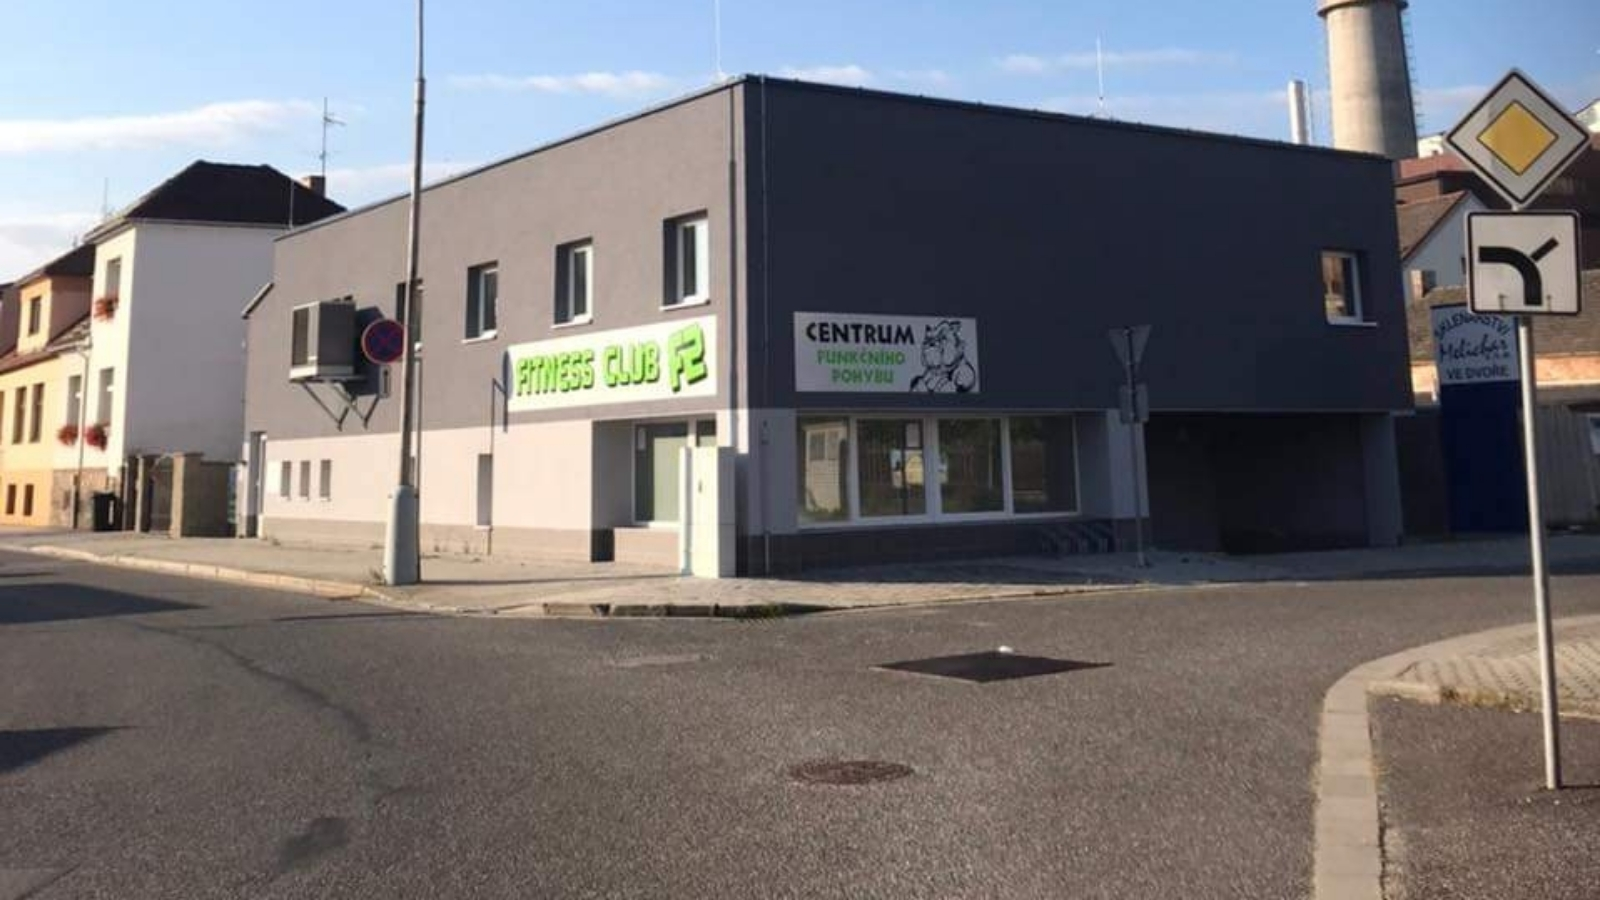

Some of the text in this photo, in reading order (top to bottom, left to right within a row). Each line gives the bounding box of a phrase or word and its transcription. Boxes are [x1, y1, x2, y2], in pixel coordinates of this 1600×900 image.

[805, 322, 915, 345] CENTRUM
[516, 349, 595, 396] FITNESS
[603, 340, 661, 387] CLUB
[832, 368, 894, 384] POHYBU
[1446, 368, 1464, 380] VE
